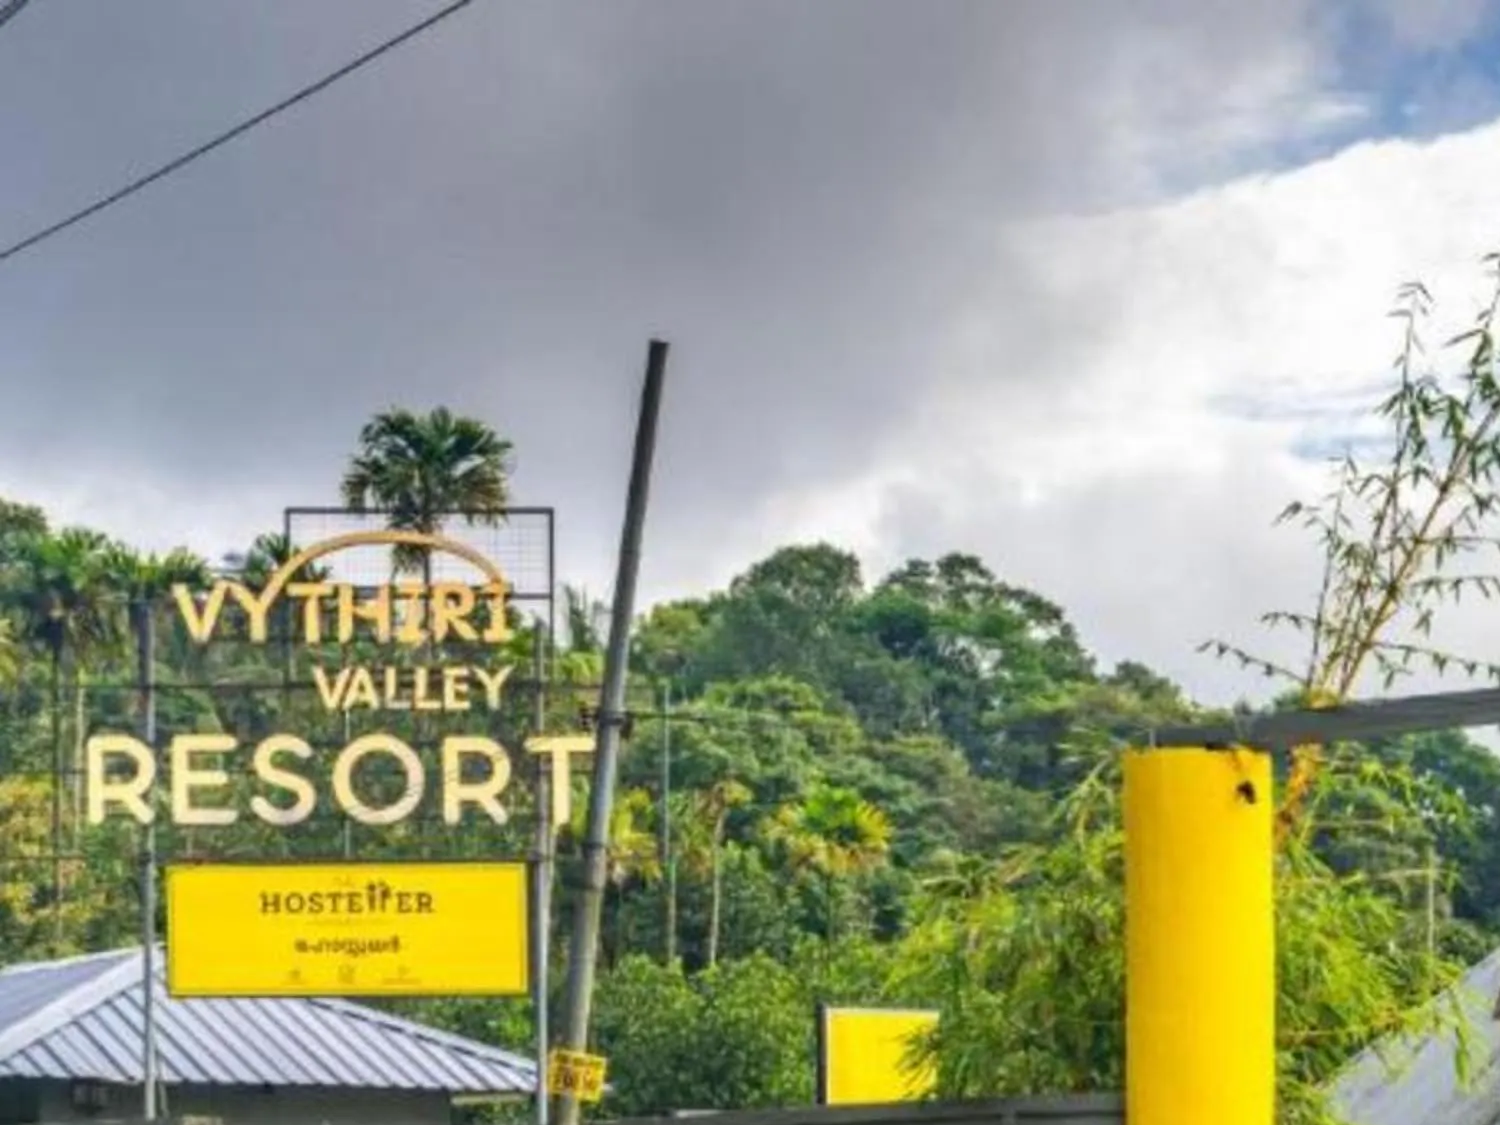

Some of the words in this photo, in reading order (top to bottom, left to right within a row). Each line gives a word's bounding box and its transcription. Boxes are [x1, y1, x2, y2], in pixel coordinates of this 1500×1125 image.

[174, 582, 513, 644] VYTHIRI
[314, 666, 513, 710] VALLEY
[86, 733, 597, 826] RESORT
